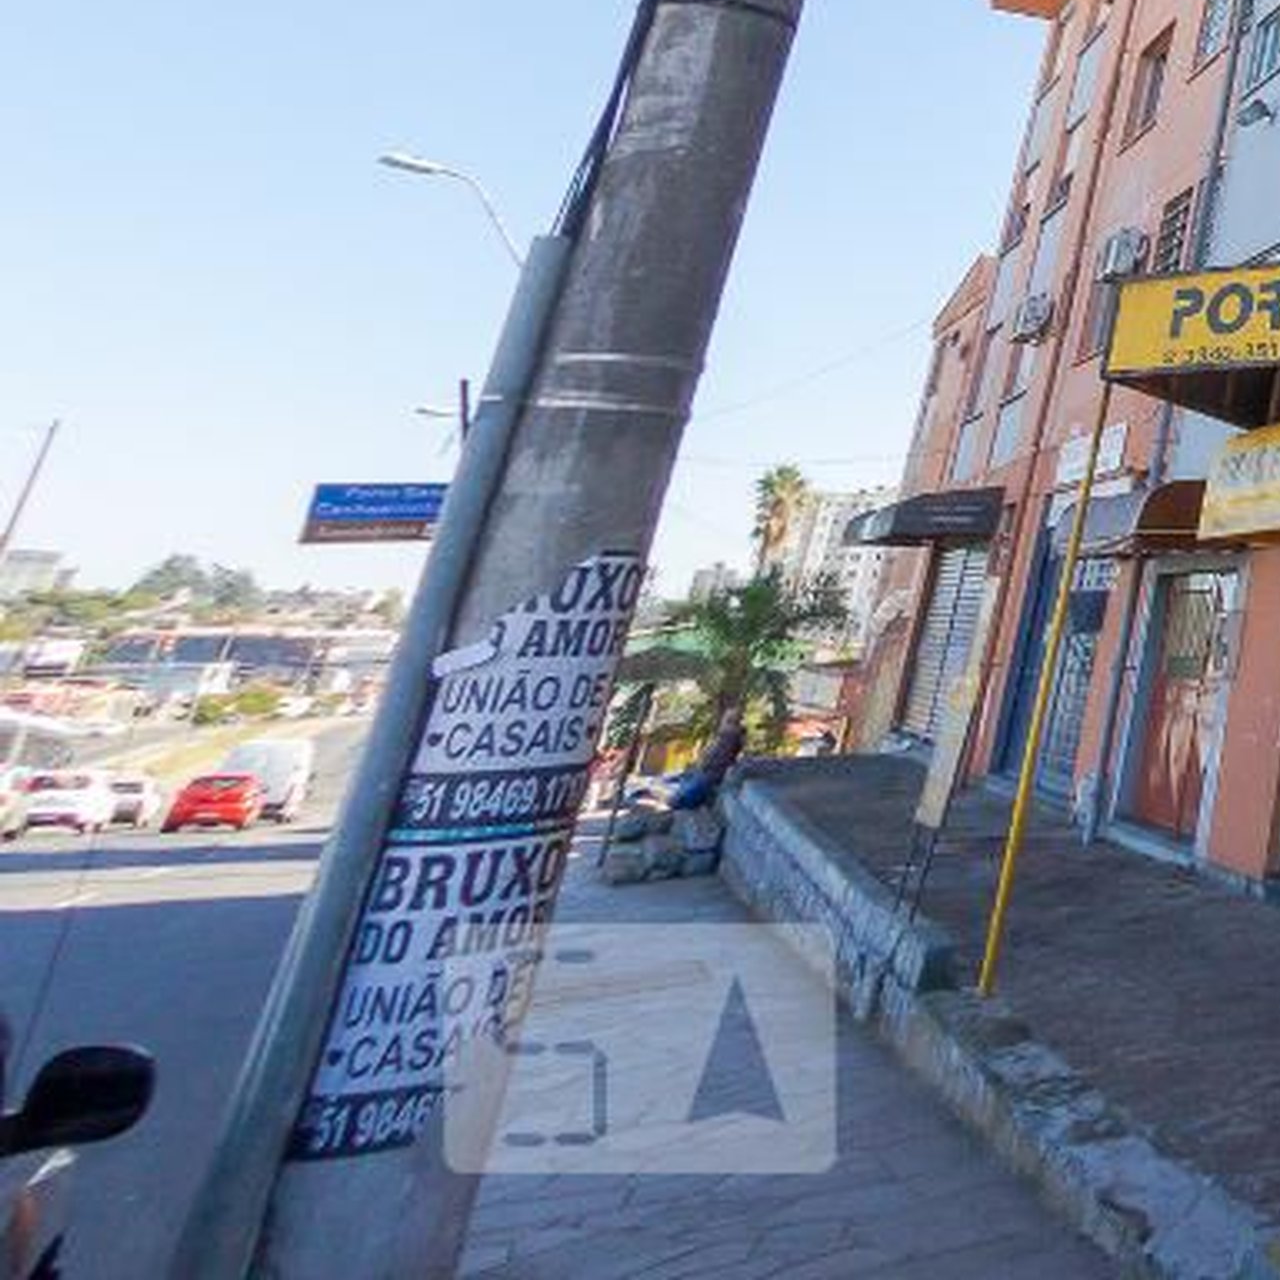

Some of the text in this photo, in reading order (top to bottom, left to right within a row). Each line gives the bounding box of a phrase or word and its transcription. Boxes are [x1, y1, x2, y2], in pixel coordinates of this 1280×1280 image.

[442, 669, 611, 715] UNIÃO DE
[444, 715, 582, 759] CASAIS
[411, 781, 448, 820] 51
[369, 839, 567, 914] BRUXO
[353, 920, 414, 966] DO
[344, 969, 475, 1029] UNIÃO
